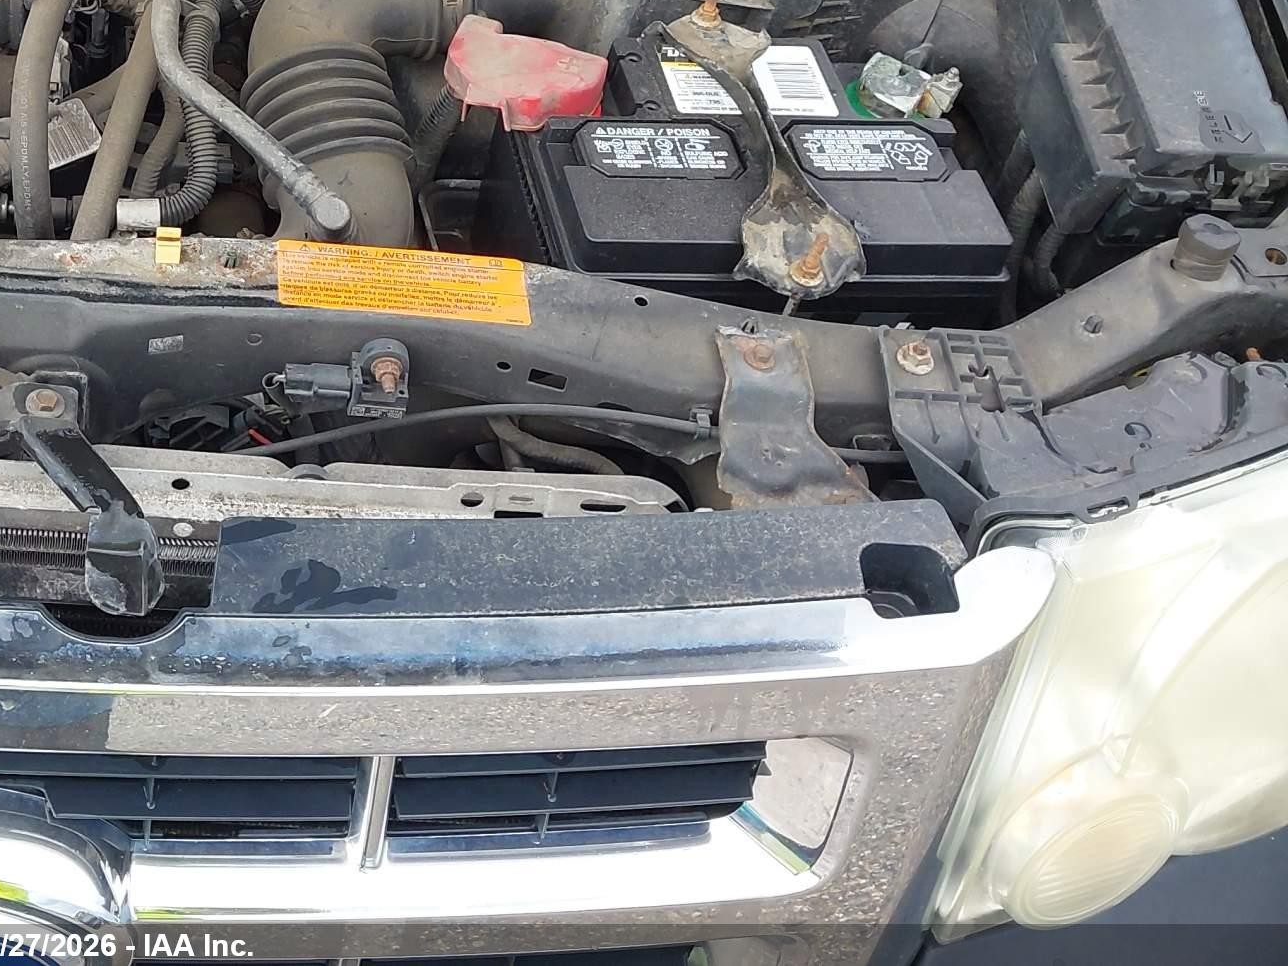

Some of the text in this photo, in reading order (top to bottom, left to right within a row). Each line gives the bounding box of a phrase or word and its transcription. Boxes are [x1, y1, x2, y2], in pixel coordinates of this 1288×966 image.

[606, 127, 655, 136] DANGER
[666, 128, 710, 136] POISON
[381, 251, 471, 264] AVERTISSEMENT
